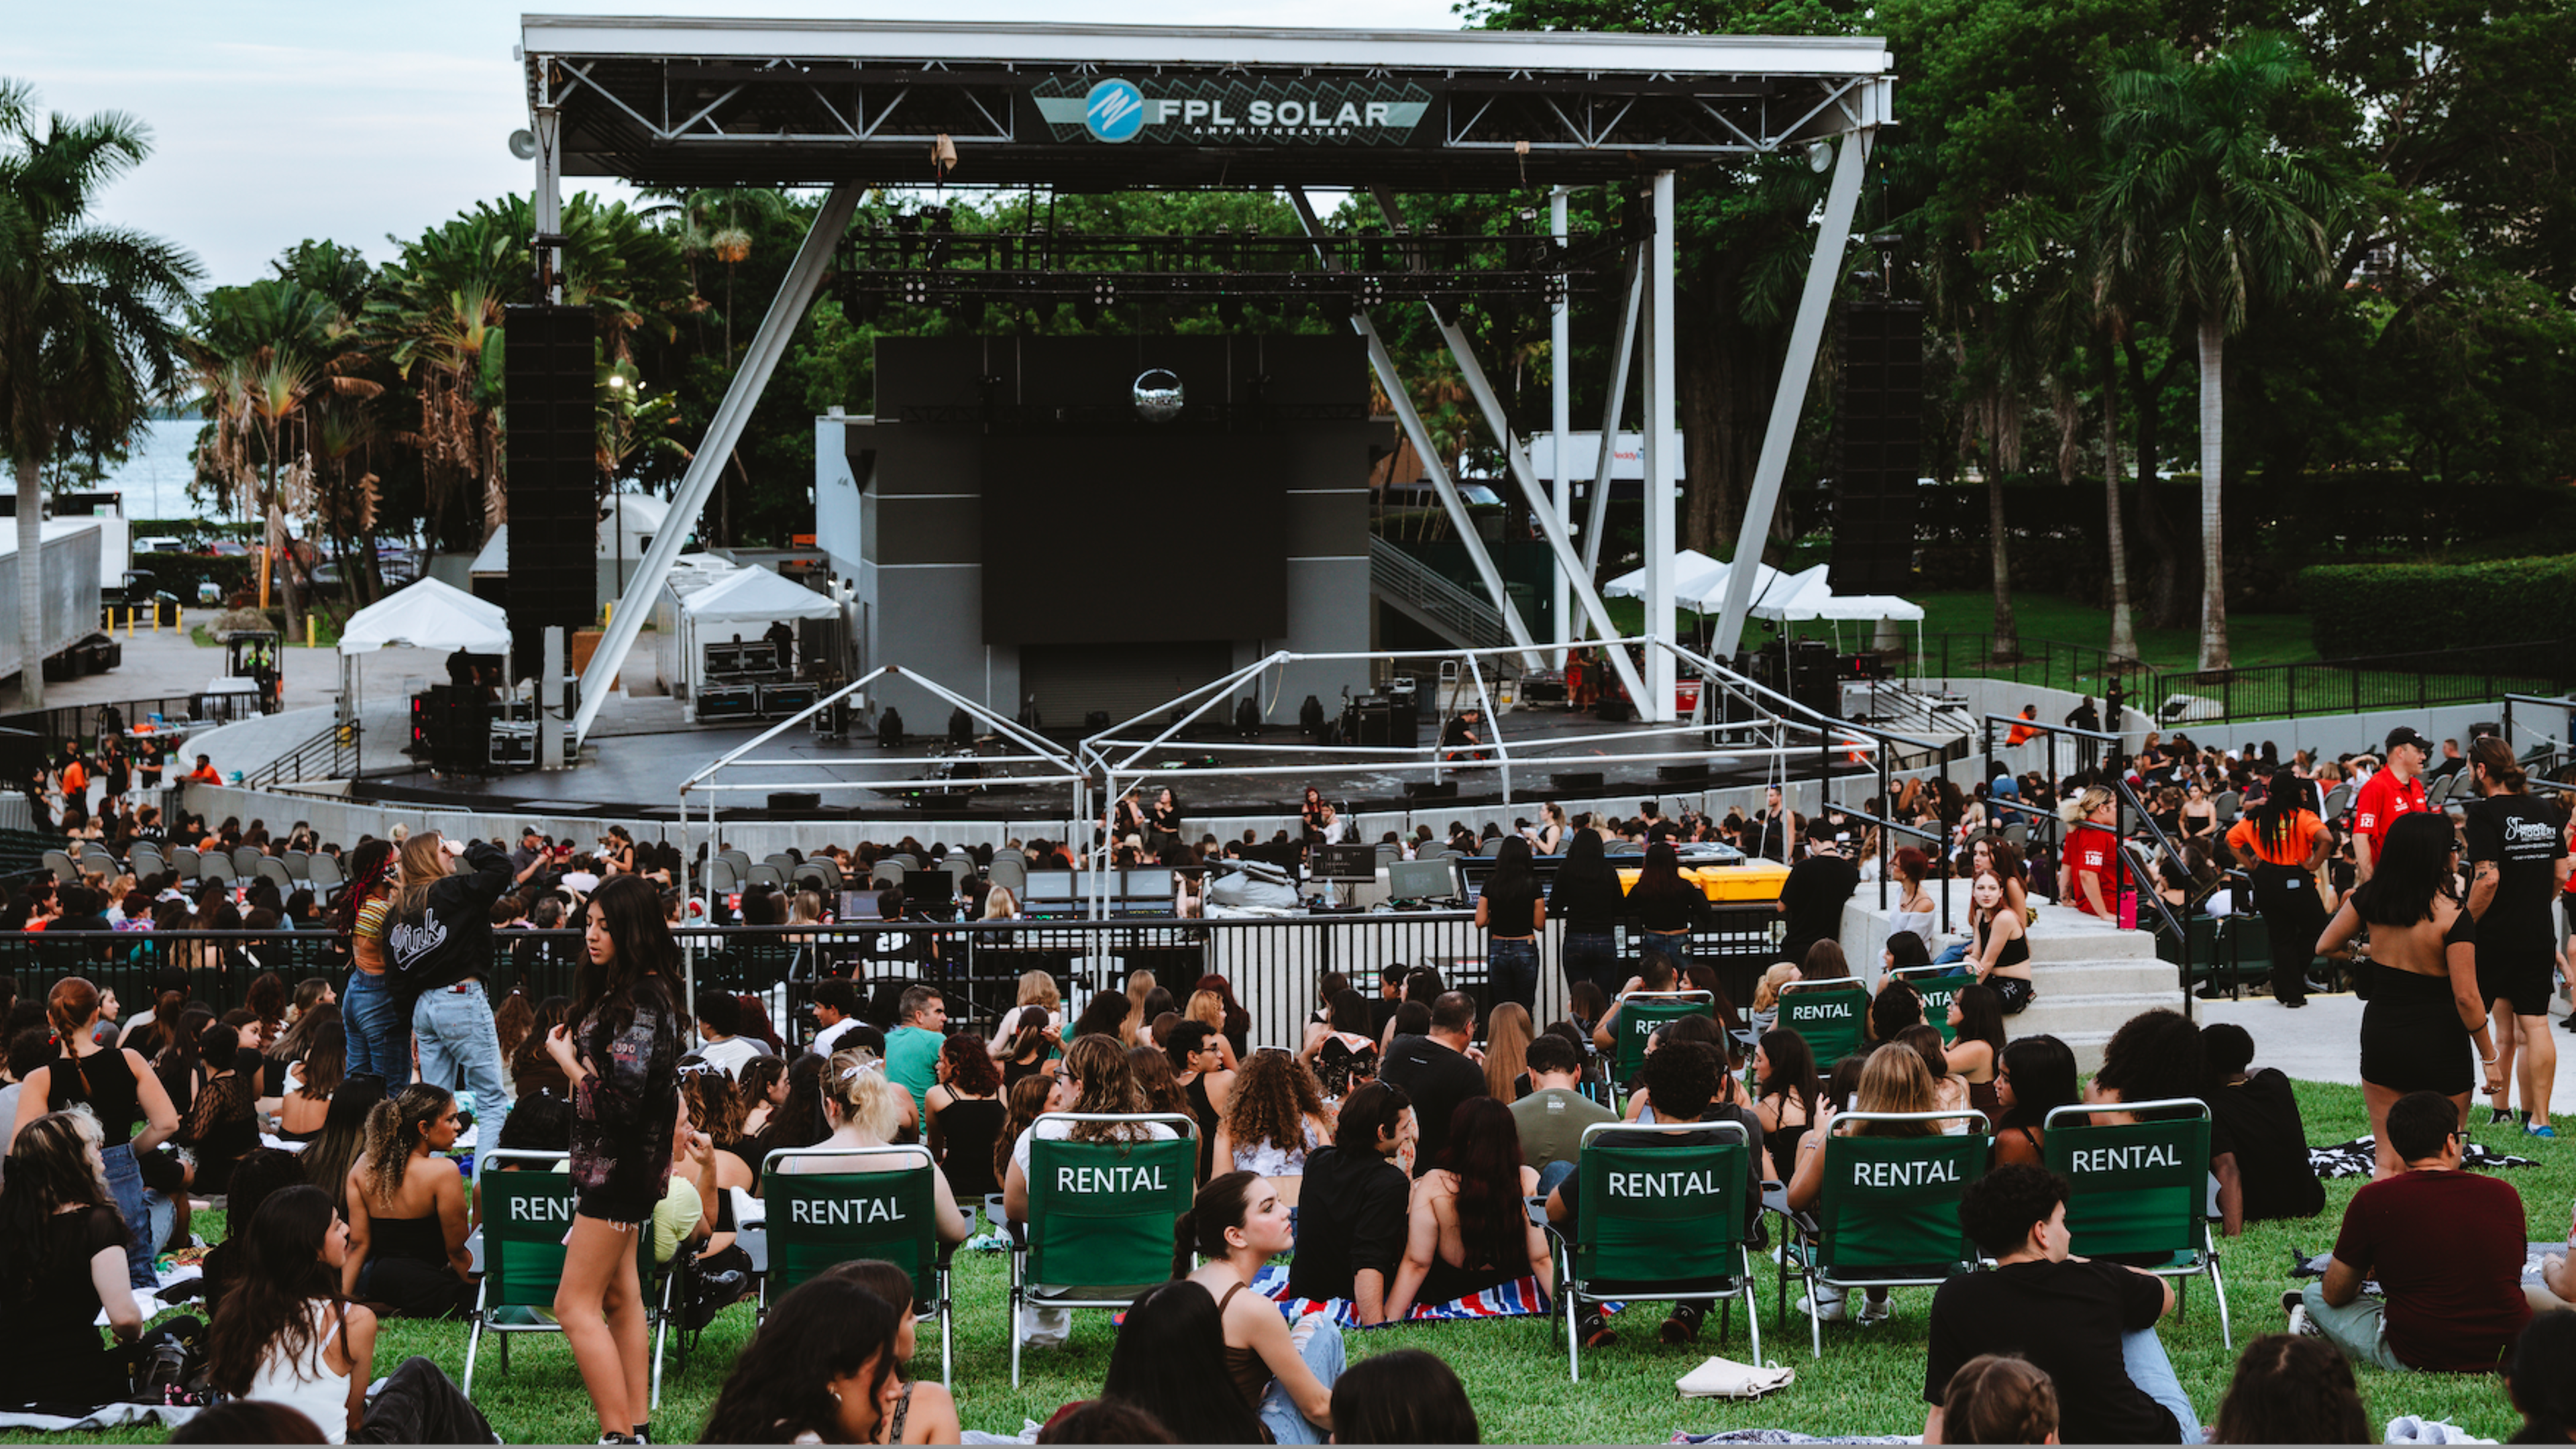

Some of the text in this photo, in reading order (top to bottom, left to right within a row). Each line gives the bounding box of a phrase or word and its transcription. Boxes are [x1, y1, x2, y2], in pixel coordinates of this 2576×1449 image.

[1158, 99, 1389, 127] FPL SOLAR
[1193, 126, 1349, 136] AMPHITHEATER
[389, 907, 447, 971] Pink
[1792, 1003, 1852, 1020] RENTAL
[2072, 1144, 2182, 1173] RENTAL
[1057, 1165, 1167, 1193] RENTAL
[1609, 1169, 1720, 1197] RENTAL
[1854, 1159, 1961, 1187] RENTAL
[791, 1196, 906, 1224] RENTAL
